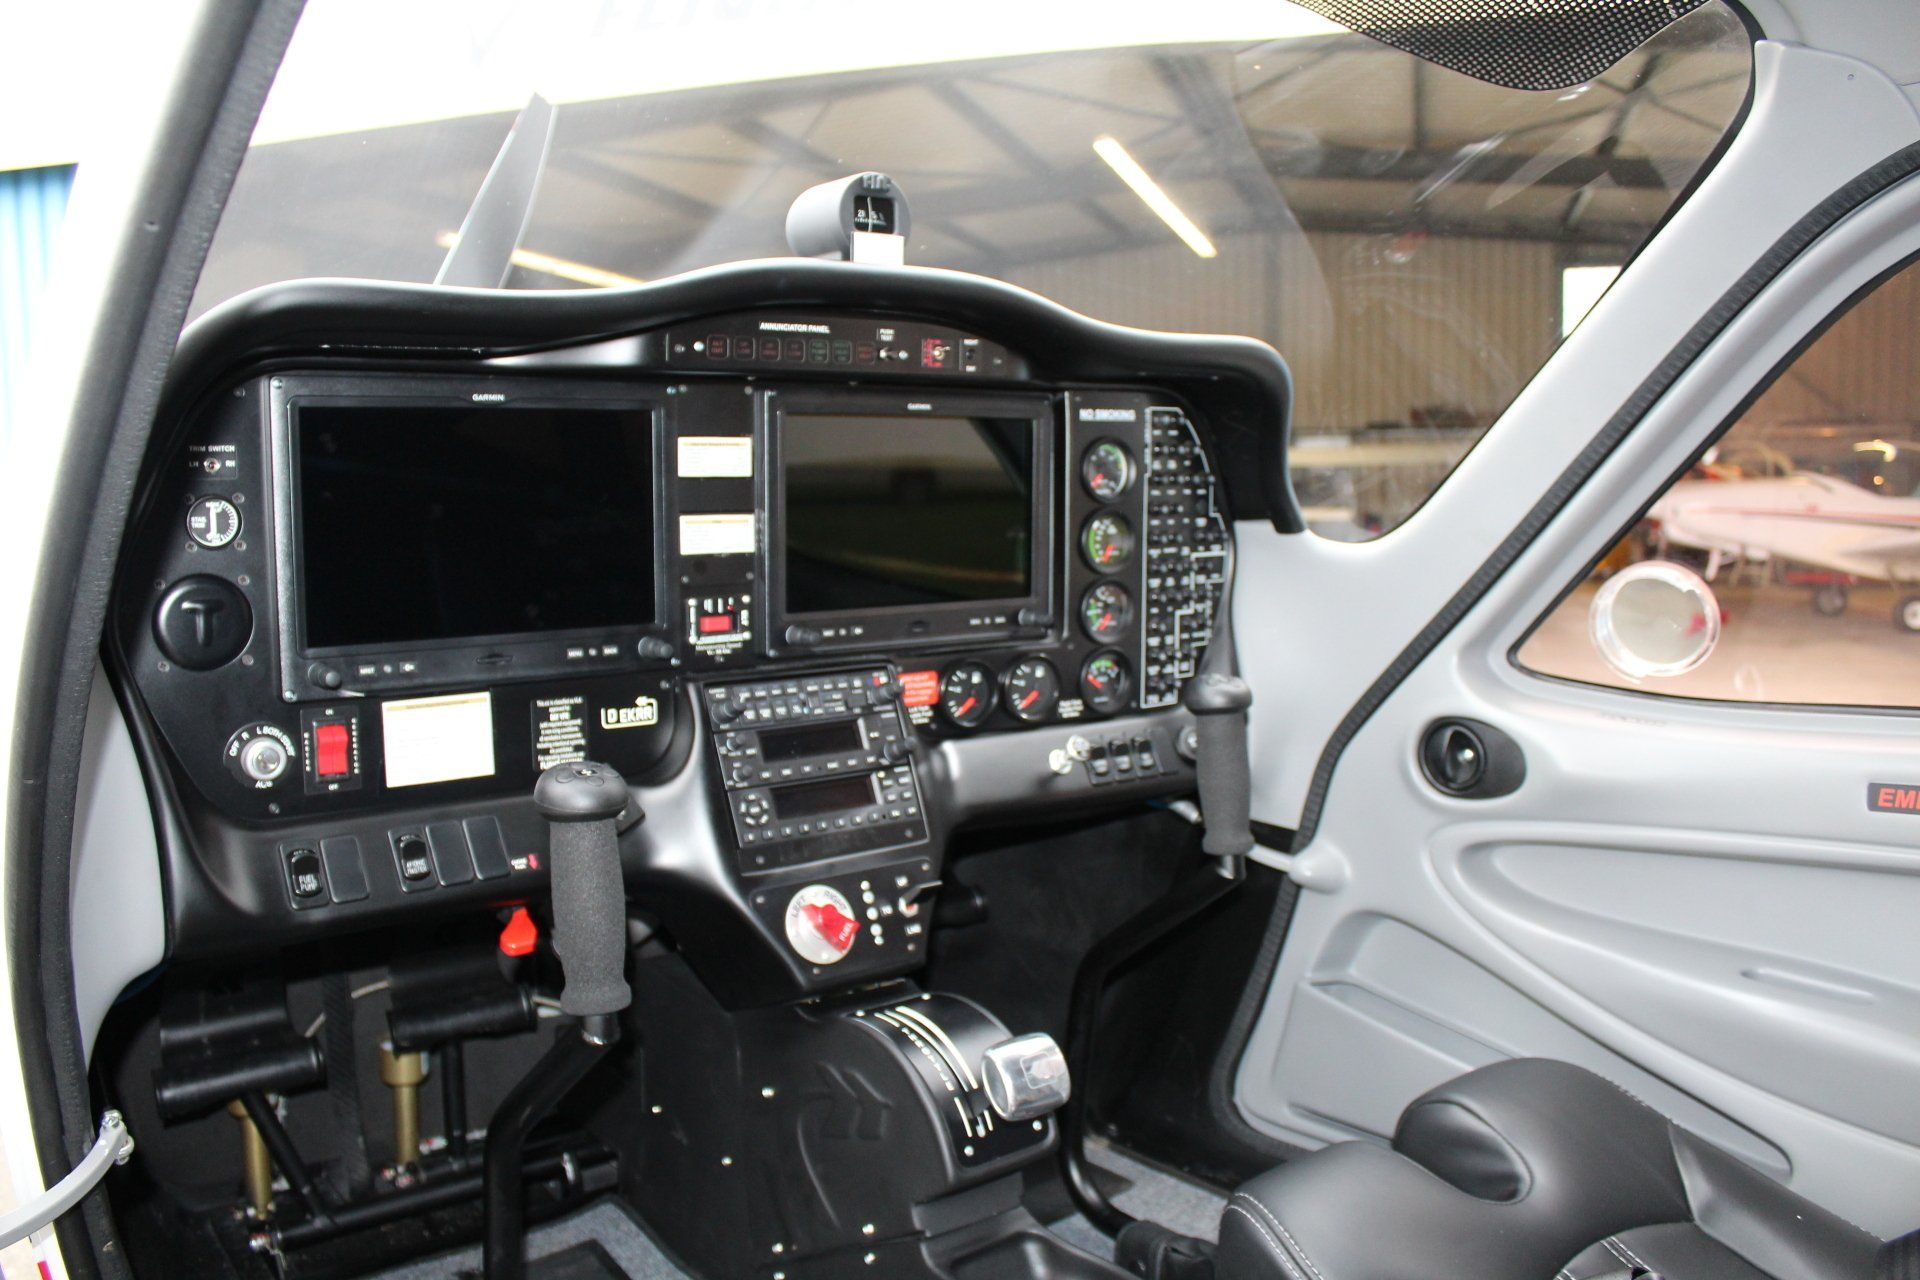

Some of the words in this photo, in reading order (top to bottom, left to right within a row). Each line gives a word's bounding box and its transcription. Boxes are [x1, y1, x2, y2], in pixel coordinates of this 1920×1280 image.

[759, 322, 808, 333] ANNUNCIATOR
[808, 324, 830, 334] PANEL
[472, 393, 505, 401] GARMIN
[1079, 408, 1094, 422] NO
[1095, 408, 1137, 422] SMOKING
[189, 445, 206, 453] TRIM
[208, 445, 236, 453] SWITCH
[189, 460, 199, 468] LH
[225, 460, 236, 468] RH
[325, 708, 335, 716] ON
[256, 725, 262, 735] L
[241, 731, 251, 741] R
[229, 740, 241, 757] OFF
[303, 731, 312, 772] MASTER
[328, 782, 340, 791] OFF
[1878, 787, 1920, 810] EM
[299, 873, 316, 883] FUEL
[300, 881, 318, 891] PUMP
